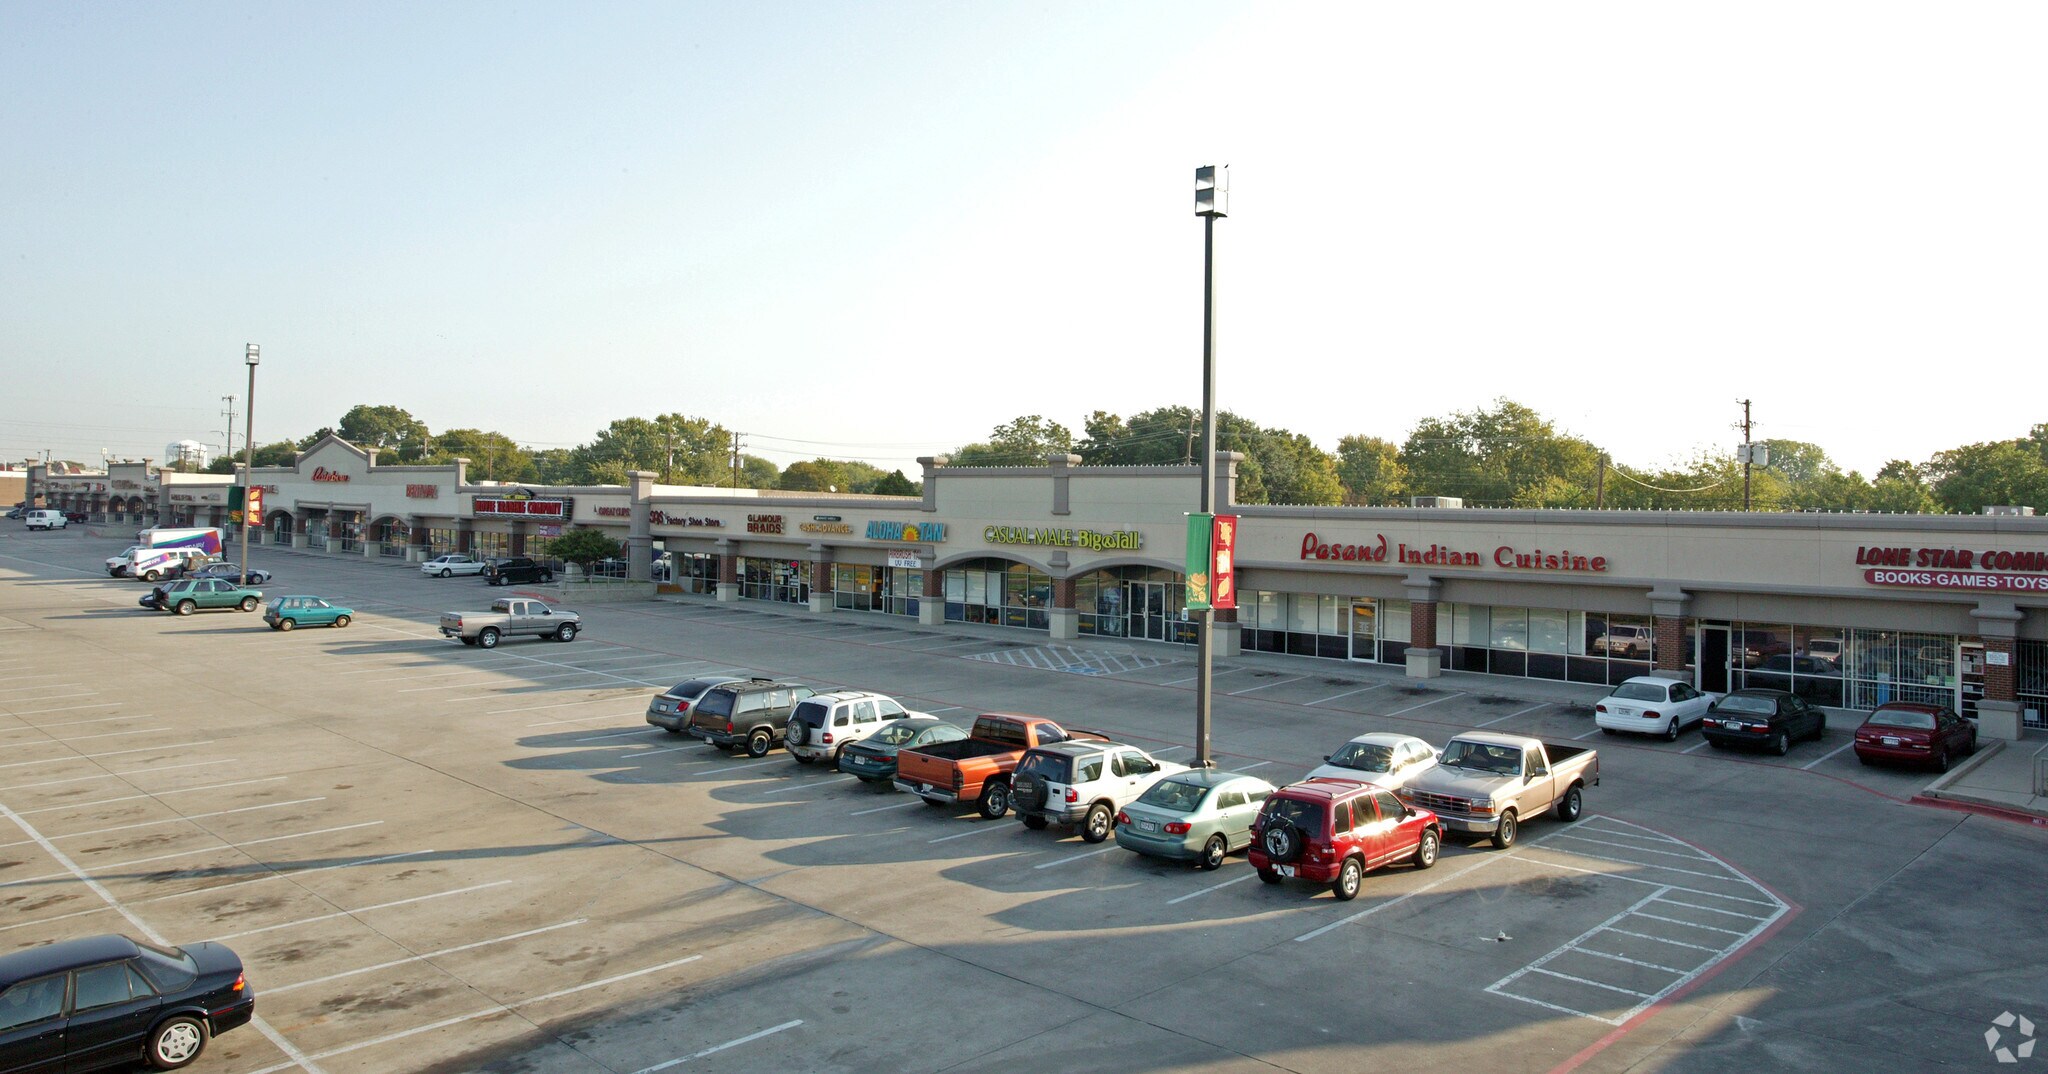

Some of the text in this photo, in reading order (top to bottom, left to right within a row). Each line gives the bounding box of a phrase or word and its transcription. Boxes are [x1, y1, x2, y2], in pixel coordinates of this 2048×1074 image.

[475, 500, 561, 514] MOVIE TRADING COMPANY
[666, 516, 686, 528] Factory
[688, 517, 703, 526] Shoe
[704, 518, 720, 527] Store
[747, 514, 782, 523] GLAMOUR
[747, 523, 782, 534] BRAIDS
[818, 523, 849, 534] ADVANCE
[865, 521, 944, 542] ALOHA TAN
[983, 525, 1031, 545] CASUAL
[1033, 527, 1073, 547] MALE
[1300, 532, 1608, 573] Pasand Indian Cuisine
[1856, 546, 2048, 572] LONE STAR COMI
[904, 560, 917, 568] FREE
